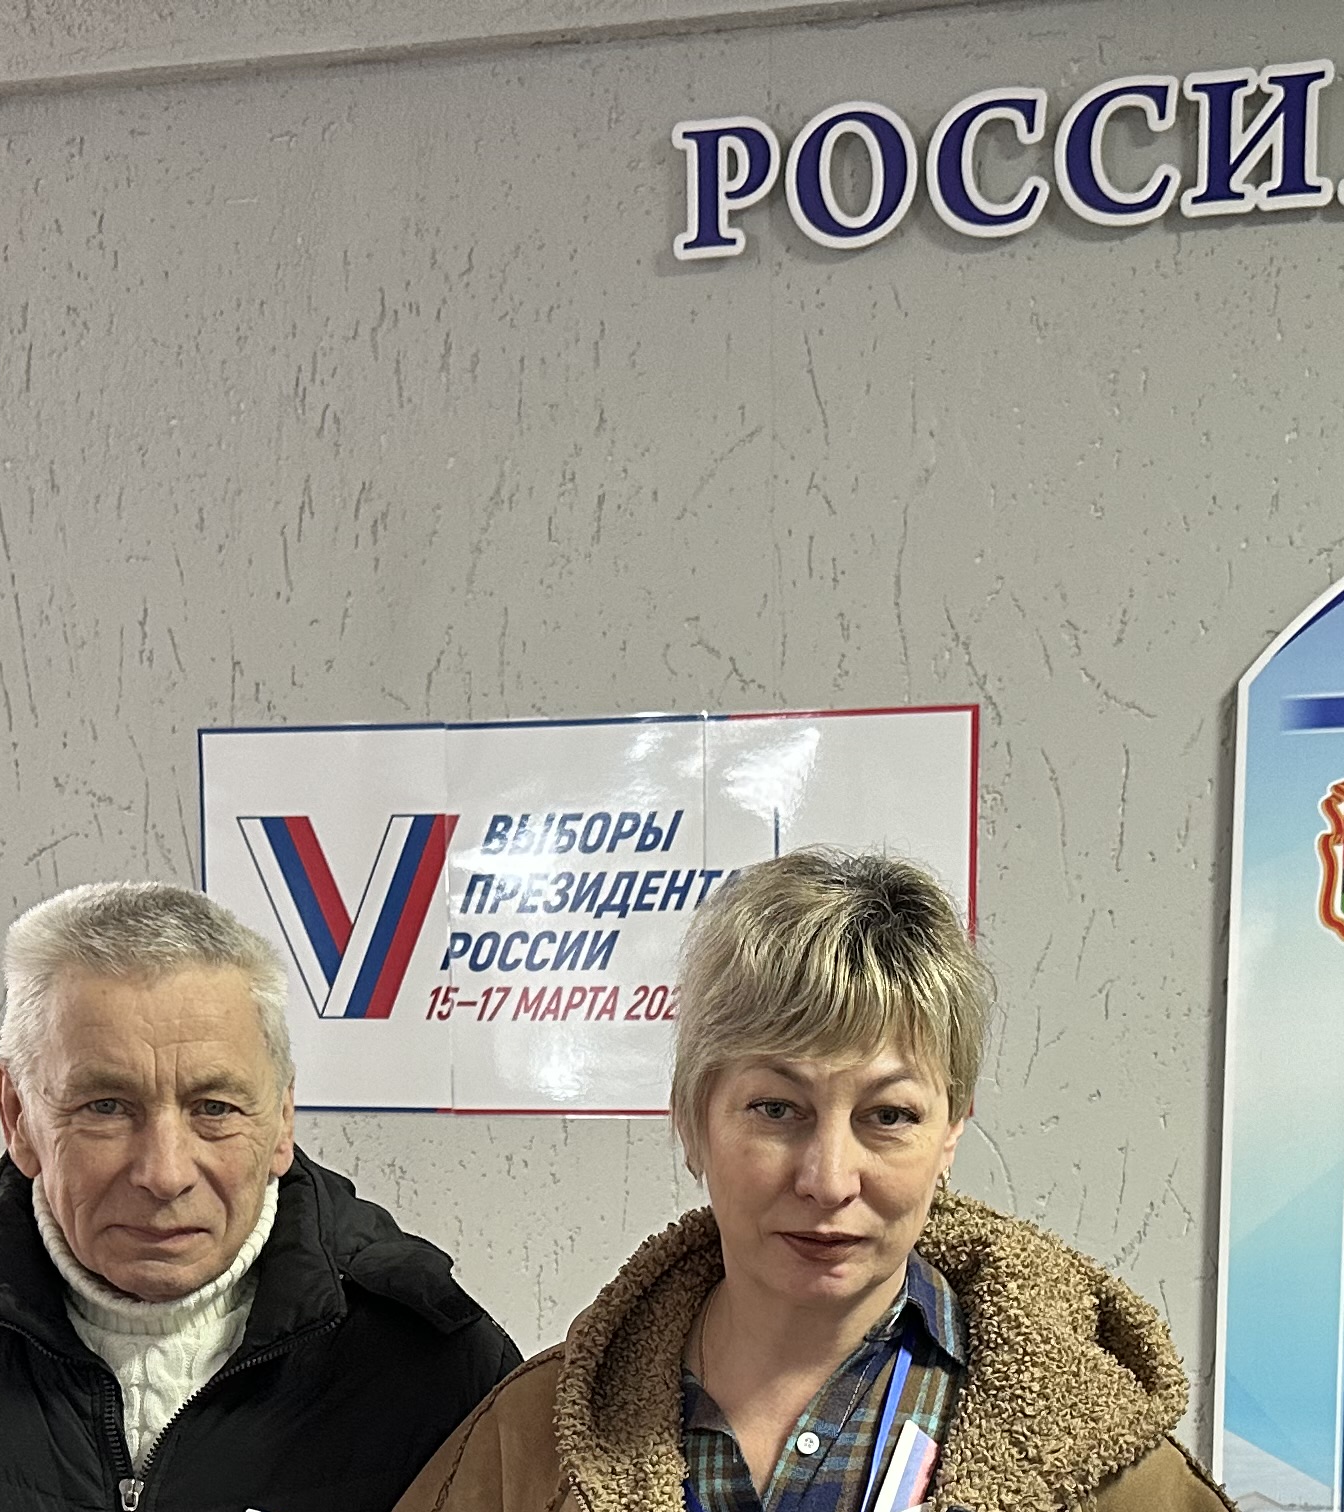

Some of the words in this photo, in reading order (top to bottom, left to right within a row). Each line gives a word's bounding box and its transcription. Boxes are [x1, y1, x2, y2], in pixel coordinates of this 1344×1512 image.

[480, 809, 685, 856] ВЫБОРЫ
[440, 929, 621, 973] РОССИИ
[511, 985, 620, 1022] МАРТА
[623, 984, 682, 1022] 202
